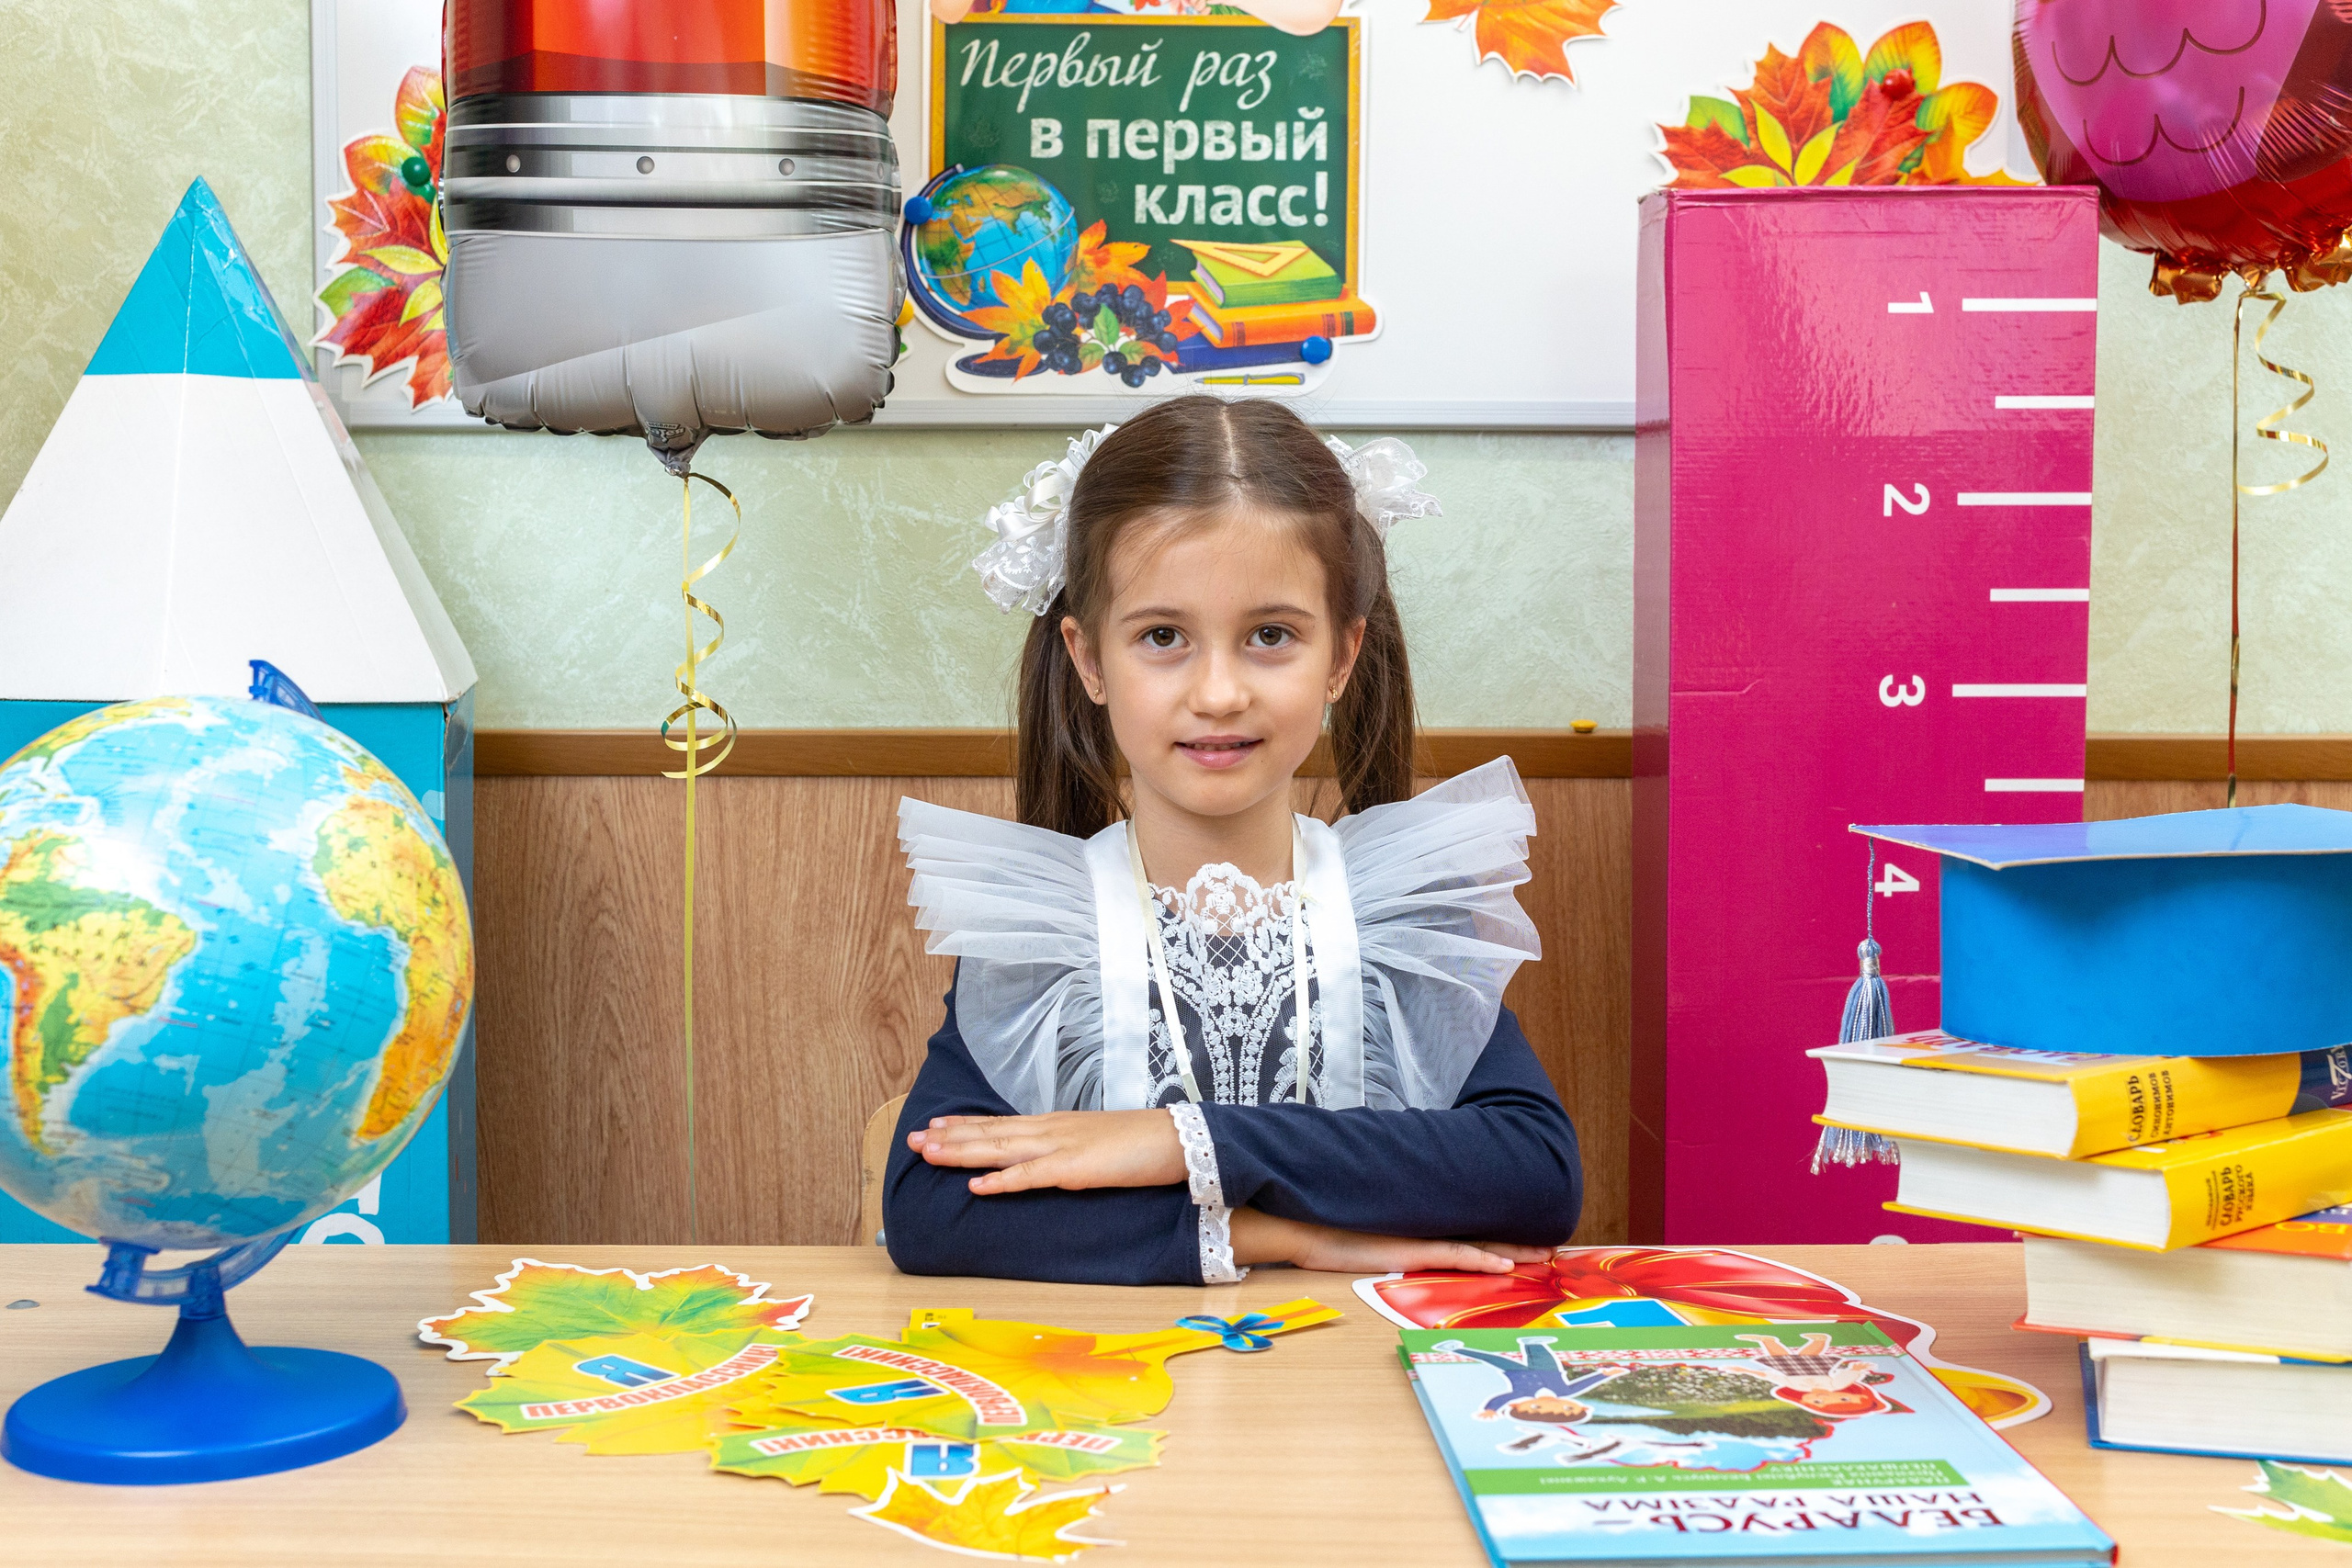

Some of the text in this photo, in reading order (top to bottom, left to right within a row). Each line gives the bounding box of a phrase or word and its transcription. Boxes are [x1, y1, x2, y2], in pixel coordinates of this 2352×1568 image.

[959, 31, 1278, 113] Первый раз
[1030, 106, 1329, 175] в первый
[1134, 171, 1329, 227] класс!
[1887, 291, 1935, 314] 1
[1883, 482, 1930, 517] 2
[1878, 674, 1926, 707] 3
[1874, 863, 1920, 897] 4
[2127, 1075, 2145, 1142] СЛОВАРЬ
[2220, 1167, 2234, 1226] СЛОВАРЬ
[577, 1354, 676, 1388] Я
[839, 1345, 1023, 1425] ПЕРВОКЛАССНИК!
[830, 1378, 945, 1404] Я
[909, 1443, 975, 1477] Я
[1581, 1492, 1984, 1511] НАША РАДЗІМА
[1649, 1507, 2006, 1533] БЕЛАРУСЬ
